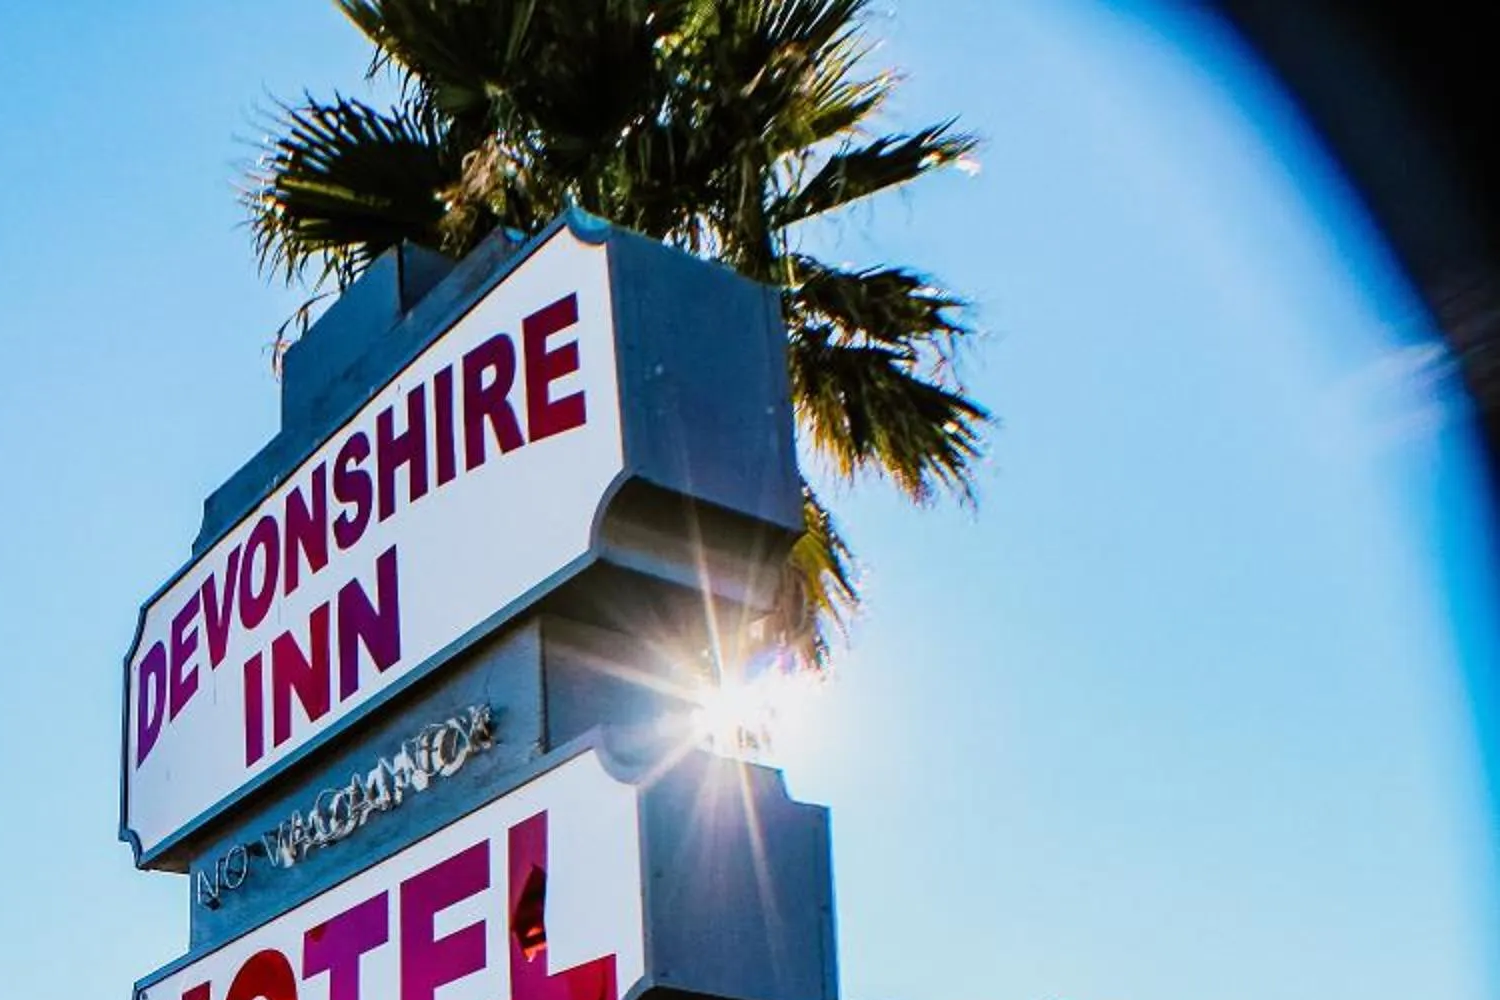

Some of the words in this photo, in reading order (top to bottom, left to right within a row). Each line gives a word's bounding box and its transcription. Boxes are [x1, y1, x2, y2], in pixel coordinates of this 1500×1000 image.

[136, 292, 588, 770] DEVONSHIRE
[244, 543, 402, 768] INN
[197, 844, 248, 905] NO
